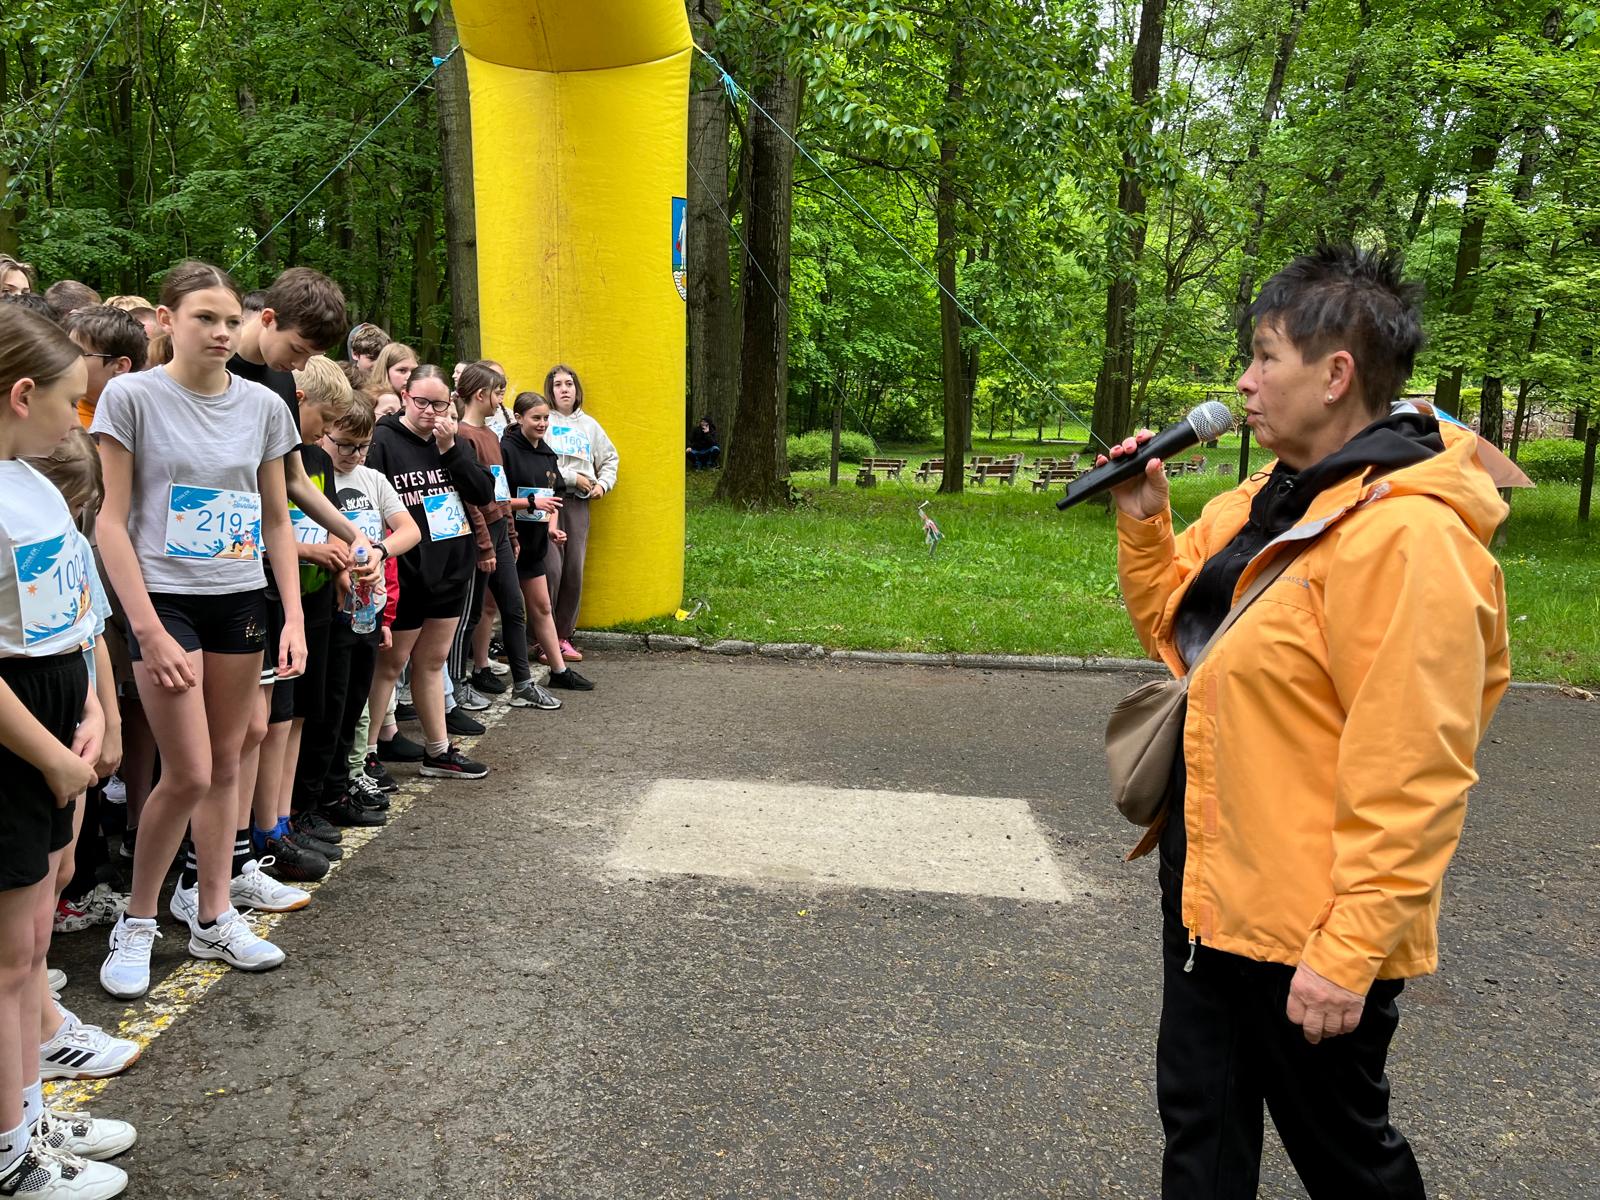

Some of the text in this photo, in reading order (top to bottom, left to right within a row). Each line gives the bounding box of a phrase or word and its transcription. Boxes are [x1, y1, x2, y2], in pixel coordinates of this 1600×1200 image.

[393, 468, 453, 490] EYES ME
[196, 509, 242, 533] 219
[445, 506, 460, 520] 24
[298, 526, 319, 544] 77
